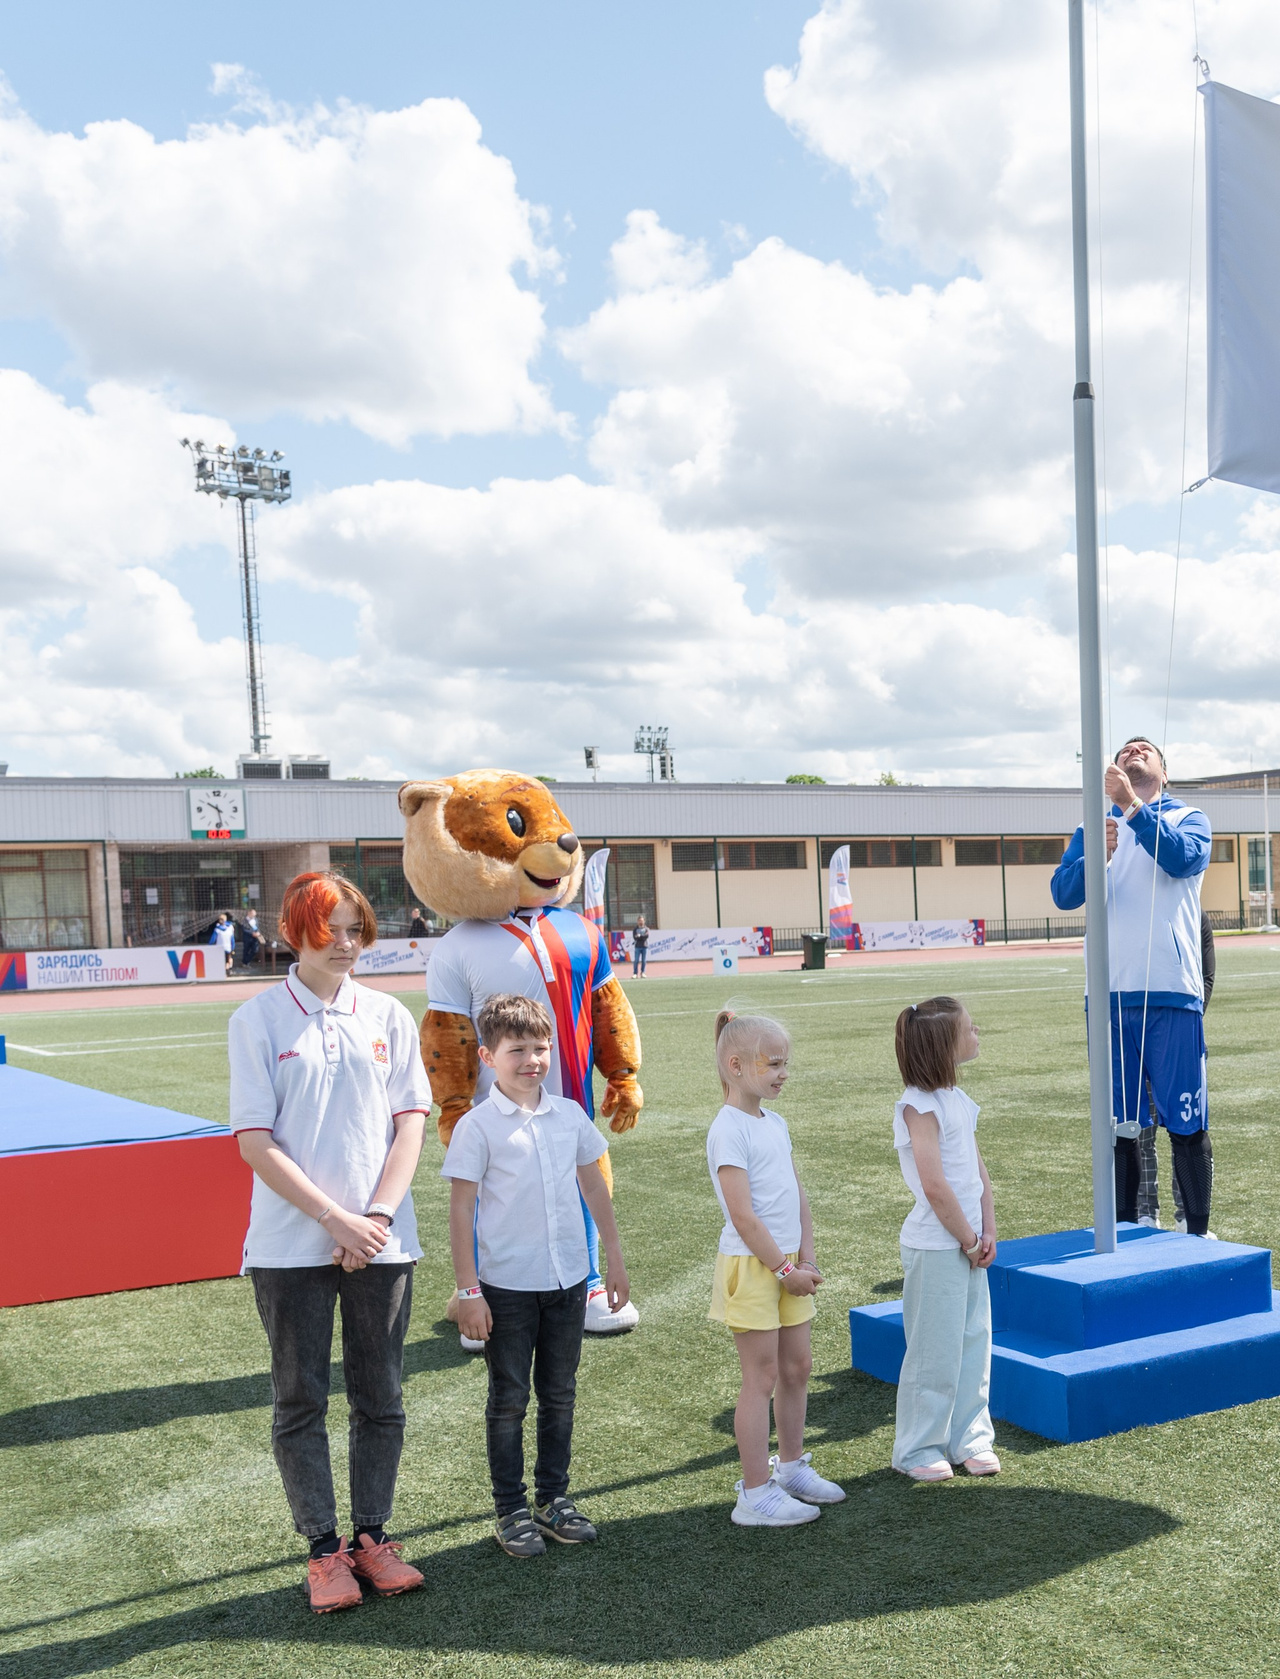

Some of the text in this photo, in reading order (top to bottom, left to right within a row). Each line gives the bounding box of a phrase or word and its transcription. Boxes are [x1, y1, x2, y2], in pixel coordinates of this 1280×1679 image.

[37, 954, 103, 970] ЗАРЯДИСЬ
[37, 967, 139, 985] НАШИМ ТЕПЛОМ!
